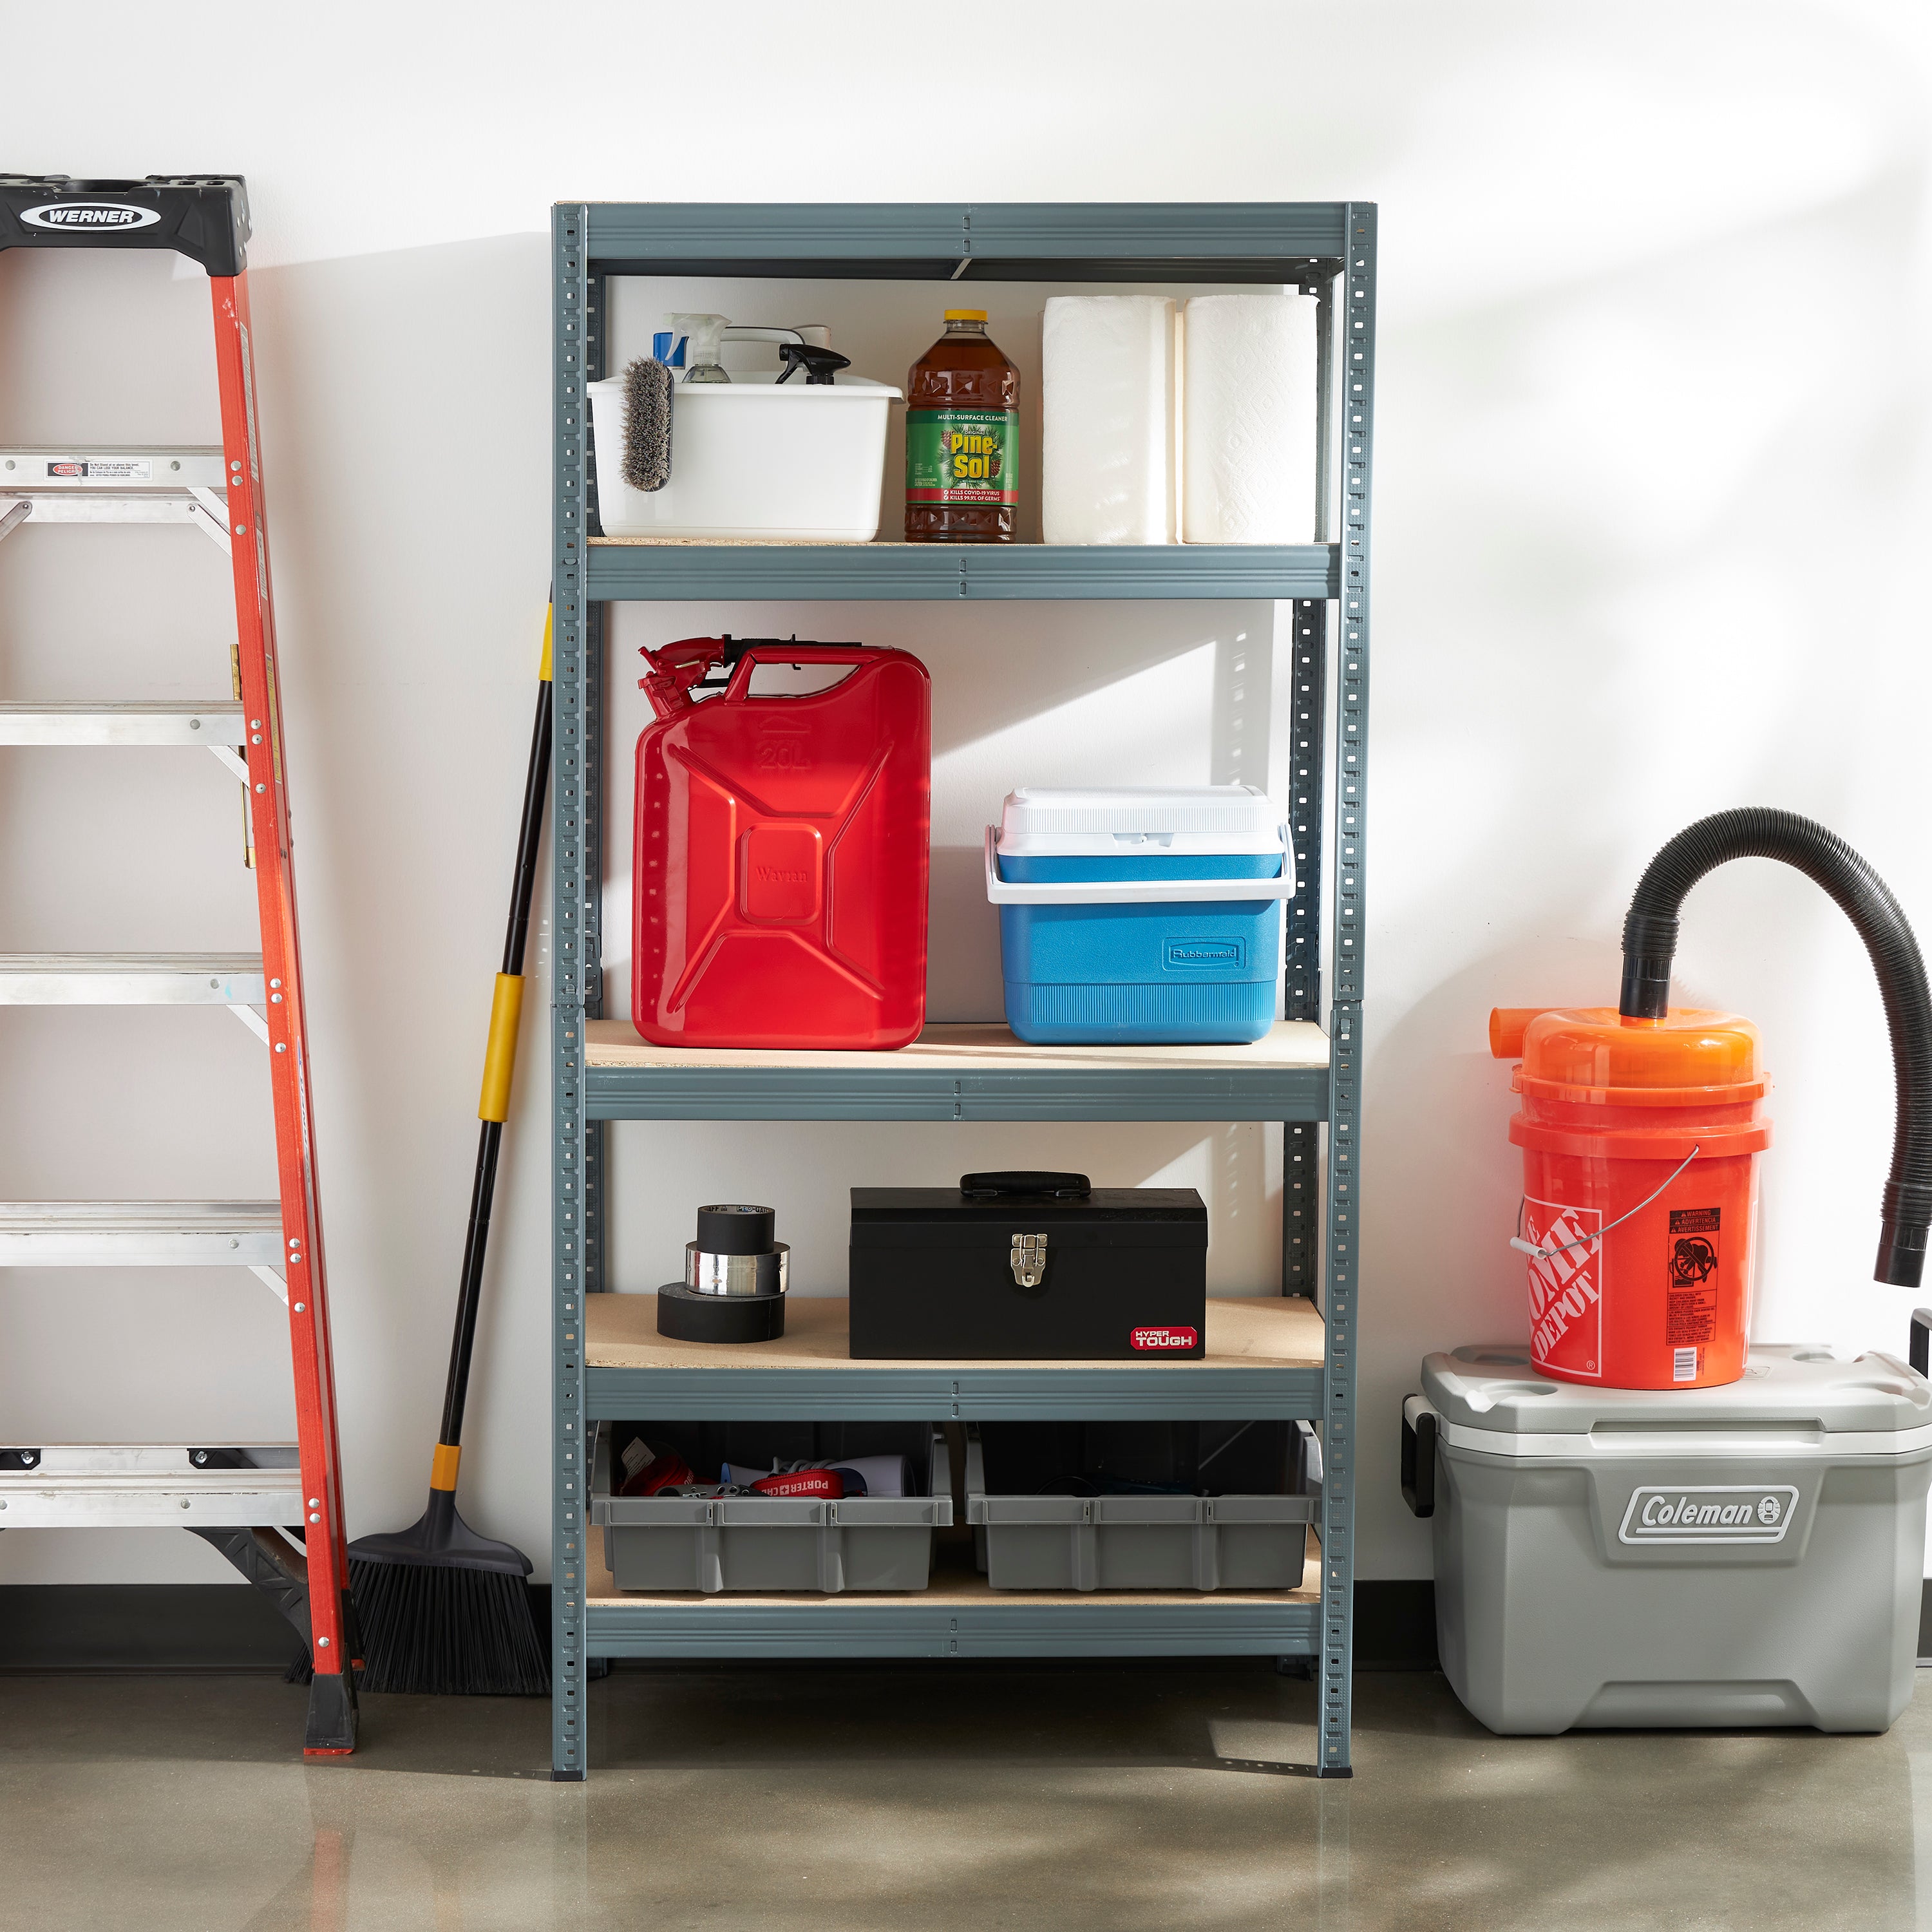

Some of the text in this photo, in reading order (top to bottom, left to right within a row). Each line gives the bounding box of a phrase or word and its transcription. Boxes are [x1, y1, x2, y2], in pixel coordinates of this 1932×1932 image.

[50, 211, 134, 222] WERNER
[954, 454, 990, 478] Sol
[1173, 948, 1236, 958] Rubbermaid
[1678, 1224, 1718, 1233] AVERTISSEMENT
[1534, 1271, 1599, 1363] DEPOT
[1135, 1336, 1192, 1347] TOUGH
[791, 1480, 829, 1493] PORTER
[1642, 1495, 1753, 1526] Coleman
